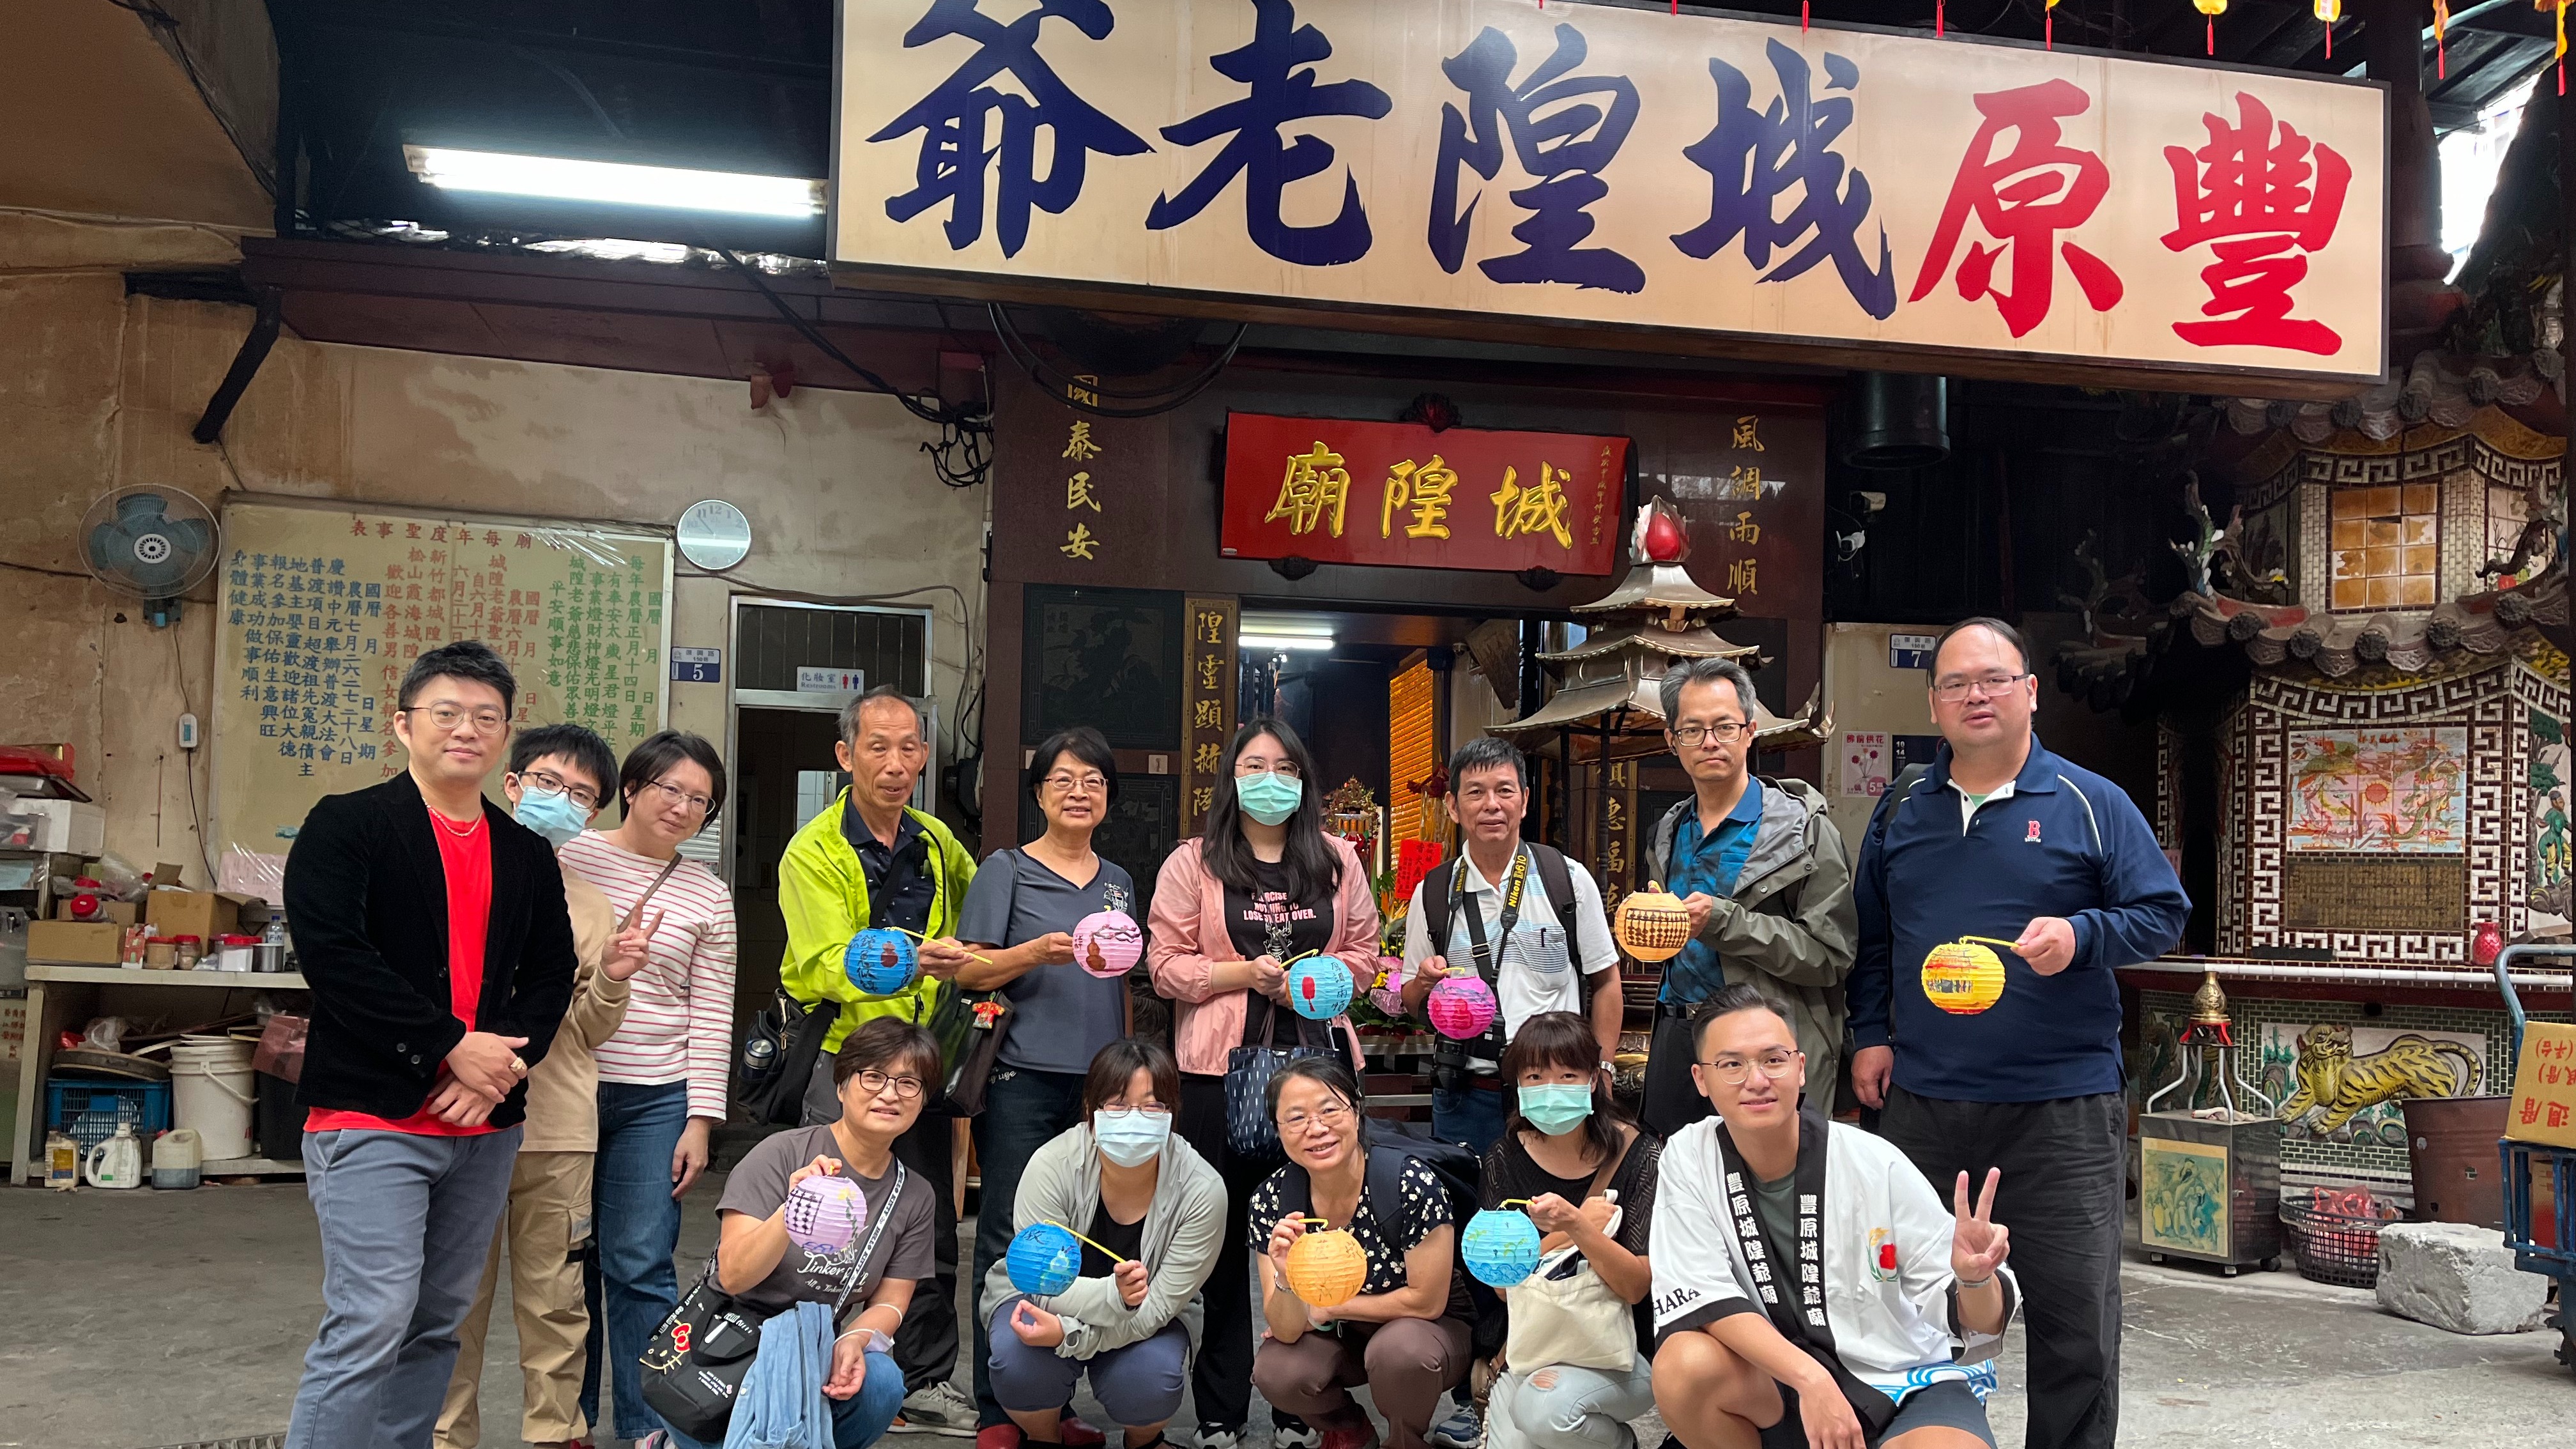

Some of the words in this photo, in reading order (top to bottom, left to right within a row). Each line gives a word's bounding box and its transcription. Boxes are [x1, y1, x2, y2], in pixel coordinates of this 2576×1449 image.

[1265, 441, 1574, 550] 城隍廟
[1727, 414, 1765, 596] 風調雨順
[227, 549, 247, 625] 身體健康
[425, 548, 447, 650] 新竹都城隍
[564, 555, 586, 724] 城隍老爺慈悲保佑眾善
[693, 664, 703, 680] 5
[1912, 650, 1921, 667] 7
[1508, 879, 1521, 907] Nikon
[1513, 855, 1527, 879] D610
[1243, 910, 1263, 921] LOSE
[1291, 908, 1317, 921] OVER.
[1726, 1171, 1779, 1305] 豐原城隍爺廟
[1798, 1193, 1826, 1326] 豐原城隍爺廟
